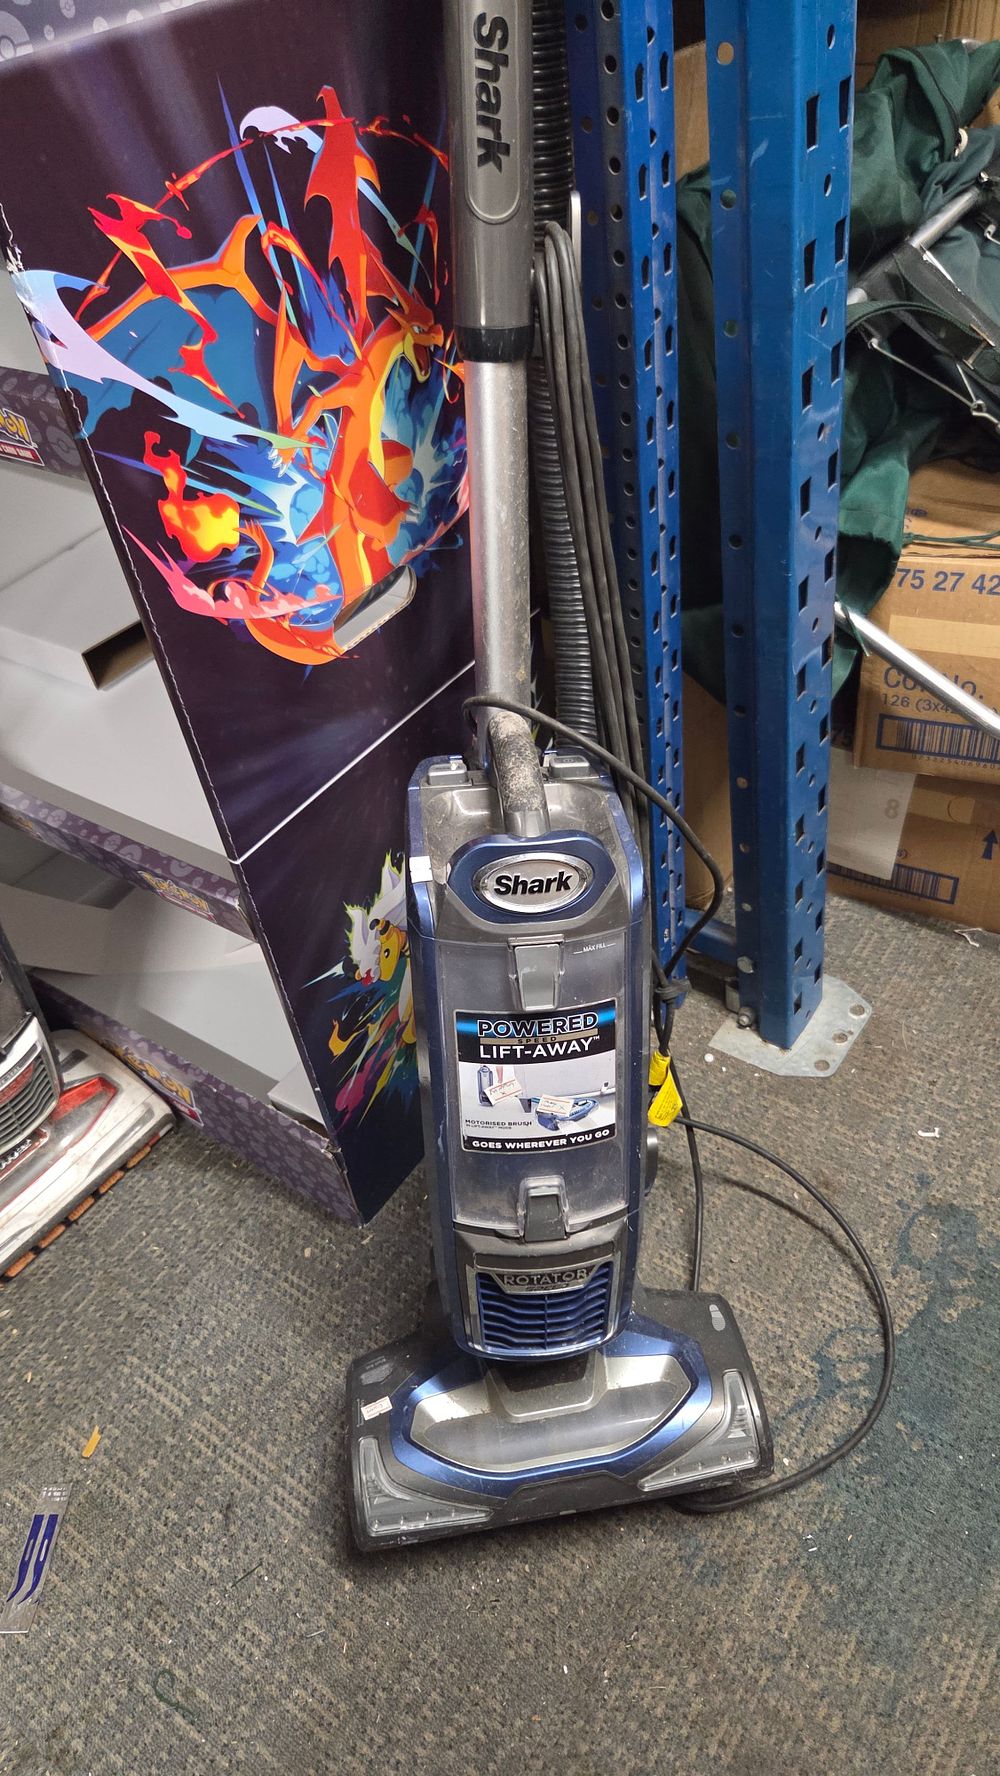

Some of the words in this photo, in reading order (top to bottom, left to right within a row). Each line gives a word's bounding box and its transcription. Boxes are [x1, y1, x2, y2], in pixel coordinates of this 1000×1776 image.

[473, 12, 510, 174] Shark
[897, 567, 925, 589] 75
[932, 570, 965, 592] 27
[971, 574, 1000, 596] 42
[882, 693, 910, 708] 126
[494, 871, 573, 895] Shark
[583, 944, 595, 952] MAX
[596, 942, 606, 950] FILL
[477, 1012, 598, 1037] POWERED
[518, 1036, 557, 1044] SPEED
[472, 1140, 502, 1149] GOES
[505, 1138, 567, 1149] WHEREVER
[570, 1134, 592, 1143] YOU
[595, 1129, 610, 1138] GO
[504, 1269, 586, 1284] ROTATOR
